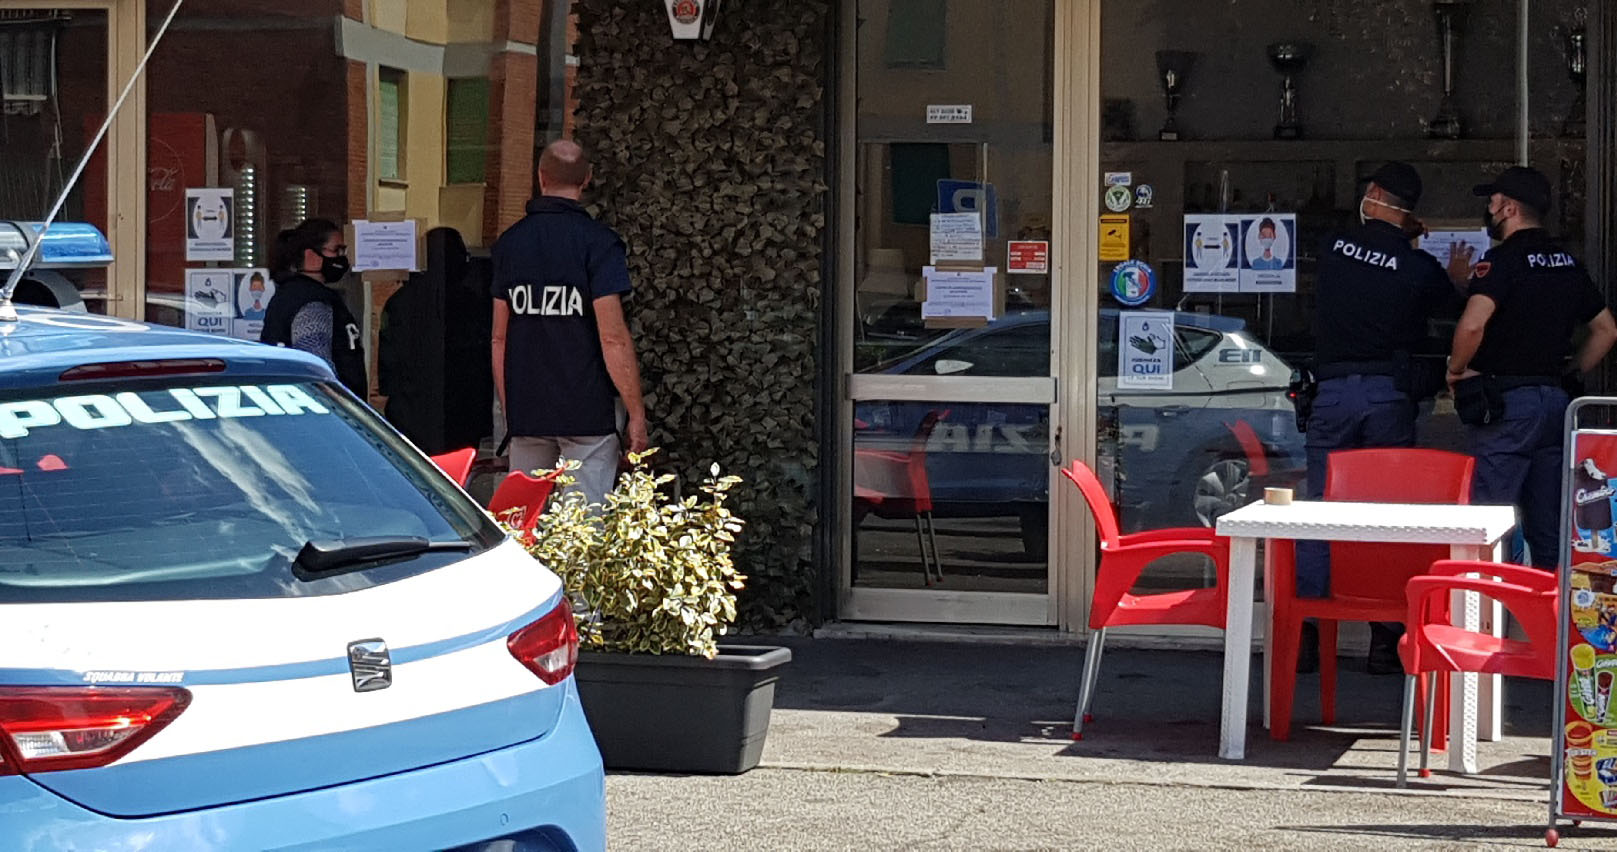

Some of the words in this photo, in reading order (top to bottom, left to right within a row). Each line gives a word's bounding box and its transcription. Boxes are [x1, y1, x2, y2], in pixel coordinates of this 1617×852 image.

[1333, 239, 1398, 271] POLIZIA
[1527, 252, 1576, 268] POIZIA
[508, 284, 583, 316] OLIZIA
[198, 316, 223, 327] QUI
[1132, 363, 1161, 375] QUI
[0, 383, 330, 439] POLIZIA
